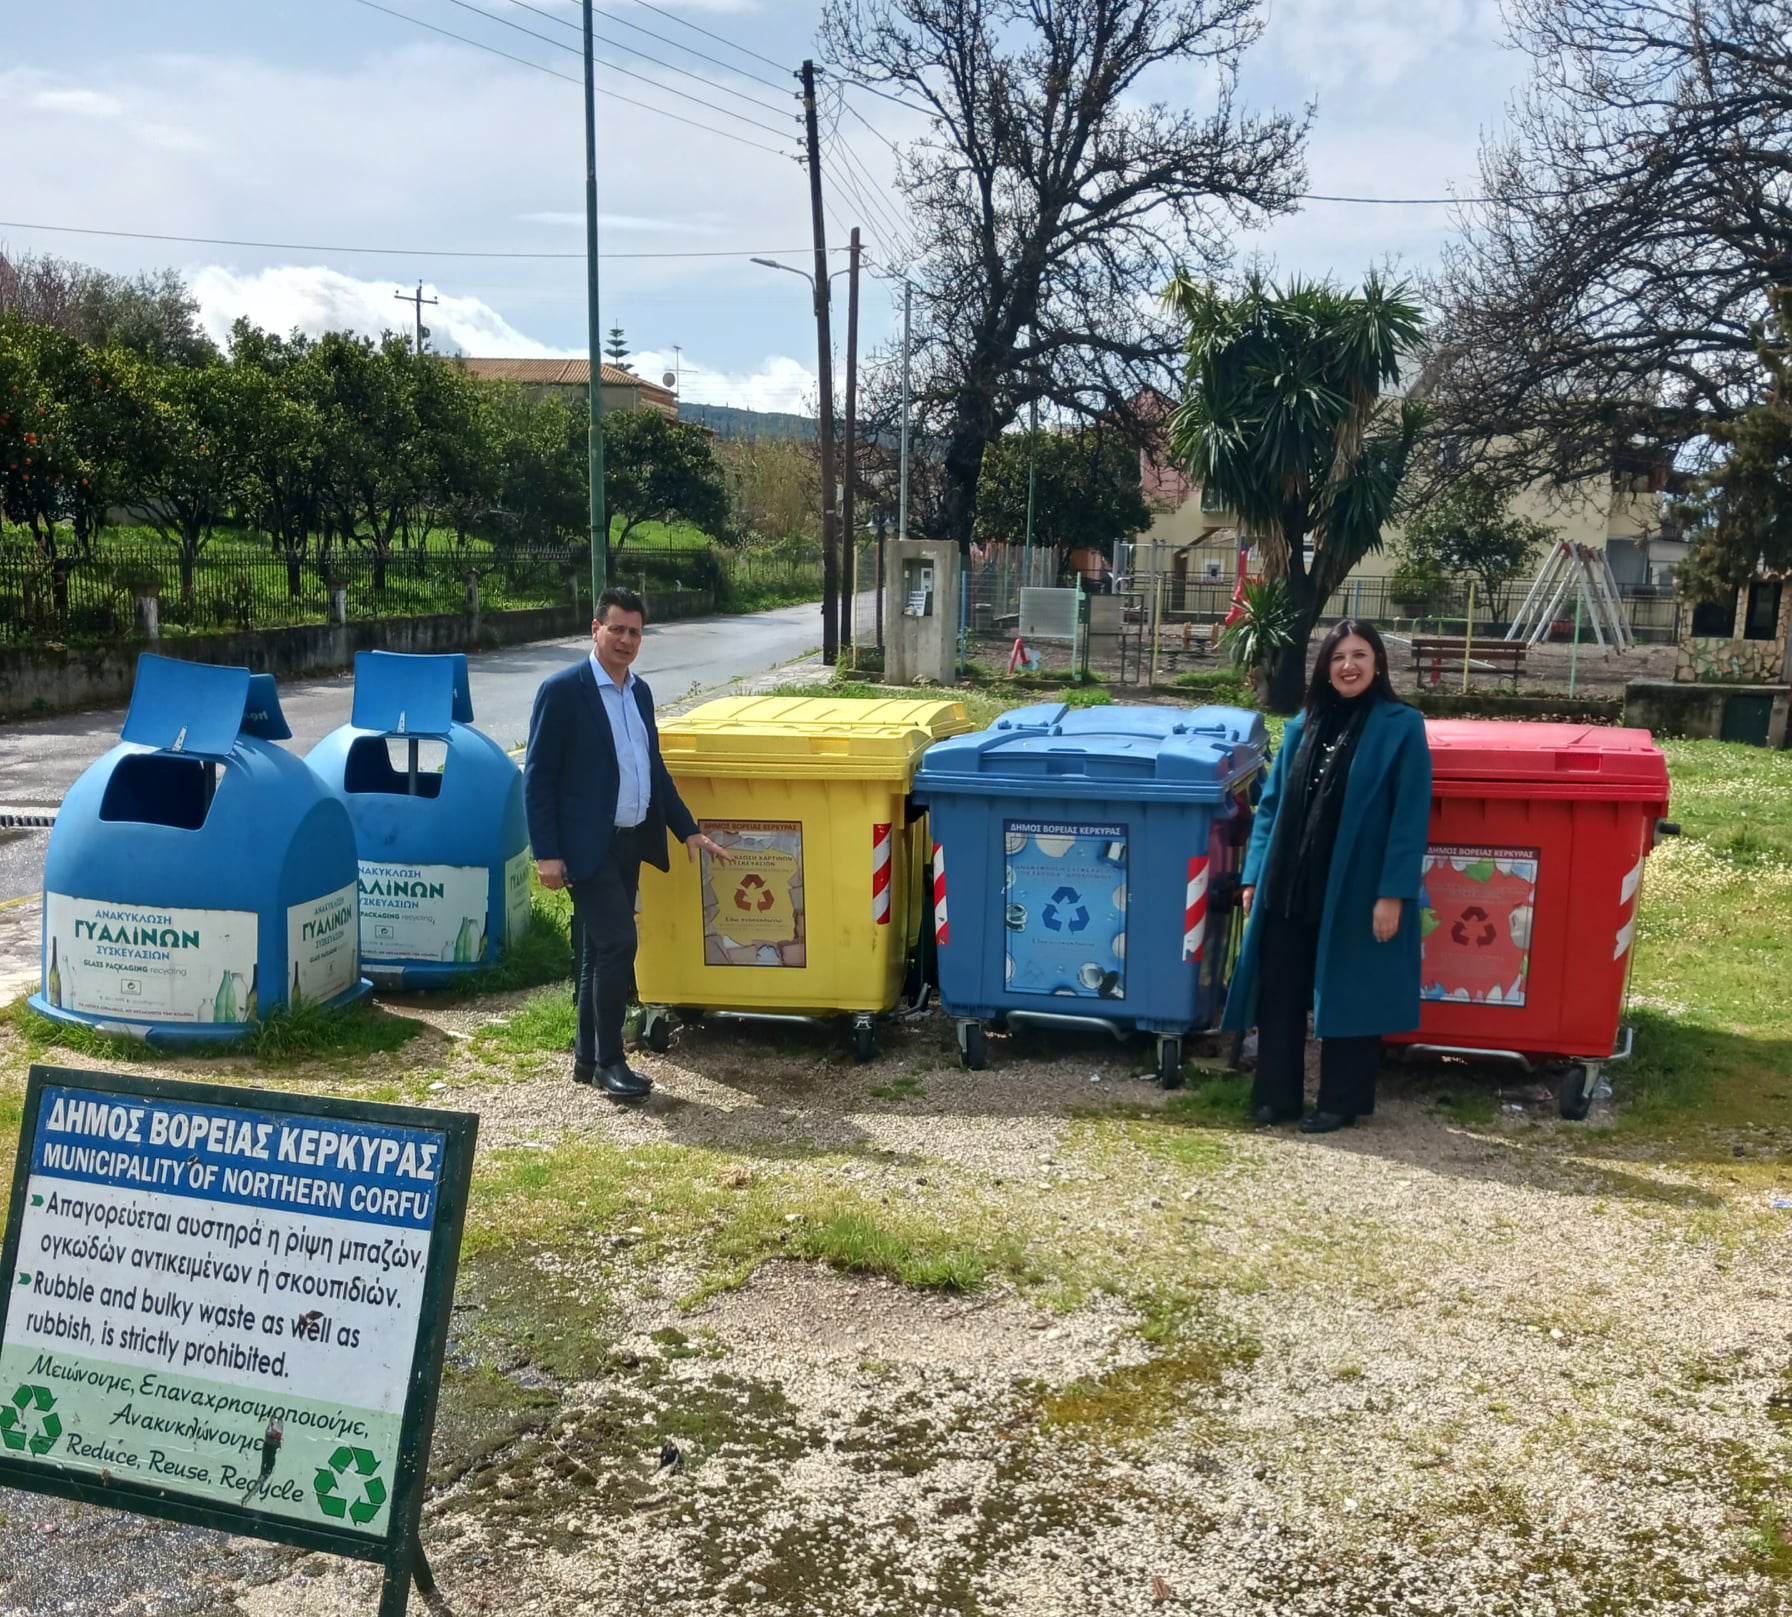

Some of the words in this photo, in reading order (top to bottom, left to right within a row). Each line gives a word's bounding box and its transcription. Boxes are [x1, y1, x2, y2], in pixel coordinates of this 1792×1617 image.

[1010, 823, 1042, 832] ΔΗΜΟΣ
[1043, 825, 1077, 834] ΒΟΡΕΙΑΣ
[1079, 826, 1121, 835] ΚΕΡΚΥΡΑΣ
[1494, 849, 1534, 858] ΚΕΡΚΥΡΑΣ
[358, 866, 421, 878] ΝΑΚΥΚΛΩΣΗ
[358, 878, 444, 899] ΑΛΙΝΩΝ
[95, 909, 172, 925] ΑΝΑΚΥΚΛΩΣΗ
[359, 897, 419, 909] ΥΣΚΕΥΑΣΙΩΝ
[401, 914, 433, 923] recycling
[75, 919, 200, 949] ΓΥΑΛΙΝΩΝ
[303, 904, 352, 942] ΓΥΑΛΙΝΩΝ
[83, 959, 104, 968] GLASS
[105, 960, 148, 973] PACKAGING
[150, 965, 187, 976] recycling
[96, 945, 170, 961] ΣΥΣΚΕΥΑΣΙΩΝ
[46, 1097, 144, 1142] ΔΗΜΟΣ
[150, 1111, 273, 1160] ΒΟΡΕΙΑΣ
[278, 1127, 438, 1180] ΚΕΡΚΥΡΑΣ
[43, 1142, 185, 1186] MUNICIPALITY
[189, 1162, 218, 1190] OF
[222, 1167, 344, 1209] NORTHERN
[350, 1185, 430, 1220] CORFU
[46, 1191, 171, 1233] Απαγορεύεται
[177, 1215, 262, 1250] αυστηρά
[267, 1229, 280, 1255] η
[284, 1225, 334, 1263] ρίψη
[338, 1238, 425, 1273] μπαζών,
[40, 1234, 127, 1265] ογκωδών
[131, 1248, 252, 1284] αντικειμένων
[257, 1259, 270, 1293] ή
[275, 1270, 402, 1309] σκουπιδιών.
[33, 1270, 95, 1303] Rubble
[100, 1286, 137, 1310] and
[141, 1287, 194, 1325] bulky
[199, 1302, 256, 1330] waste
[261, 1312, 284, 1336] as
[290, 1315, 332, 1344] well
[337, 1326, 360, 1348] as
[26, 1310, 95, 1345] rubbish,
[101, 1320, 115, 1346] is
[119, 1325, 180, 1362] strictly
[183, 1340, 289, 1378] prohibited.
[28, 1354, 135, 1397] Μειώνουμε,
[139, 1374, 369, 1439] Επαναχρησιμοποιούμε,
[109, 1403, 265, 1453] Ανακυκλώνουμε
[66, 1433, 141, 1469] Reduce,
[149, 1450, 212, 1486] Reuse,
[219, 1464, 304, 1502] Recycle
